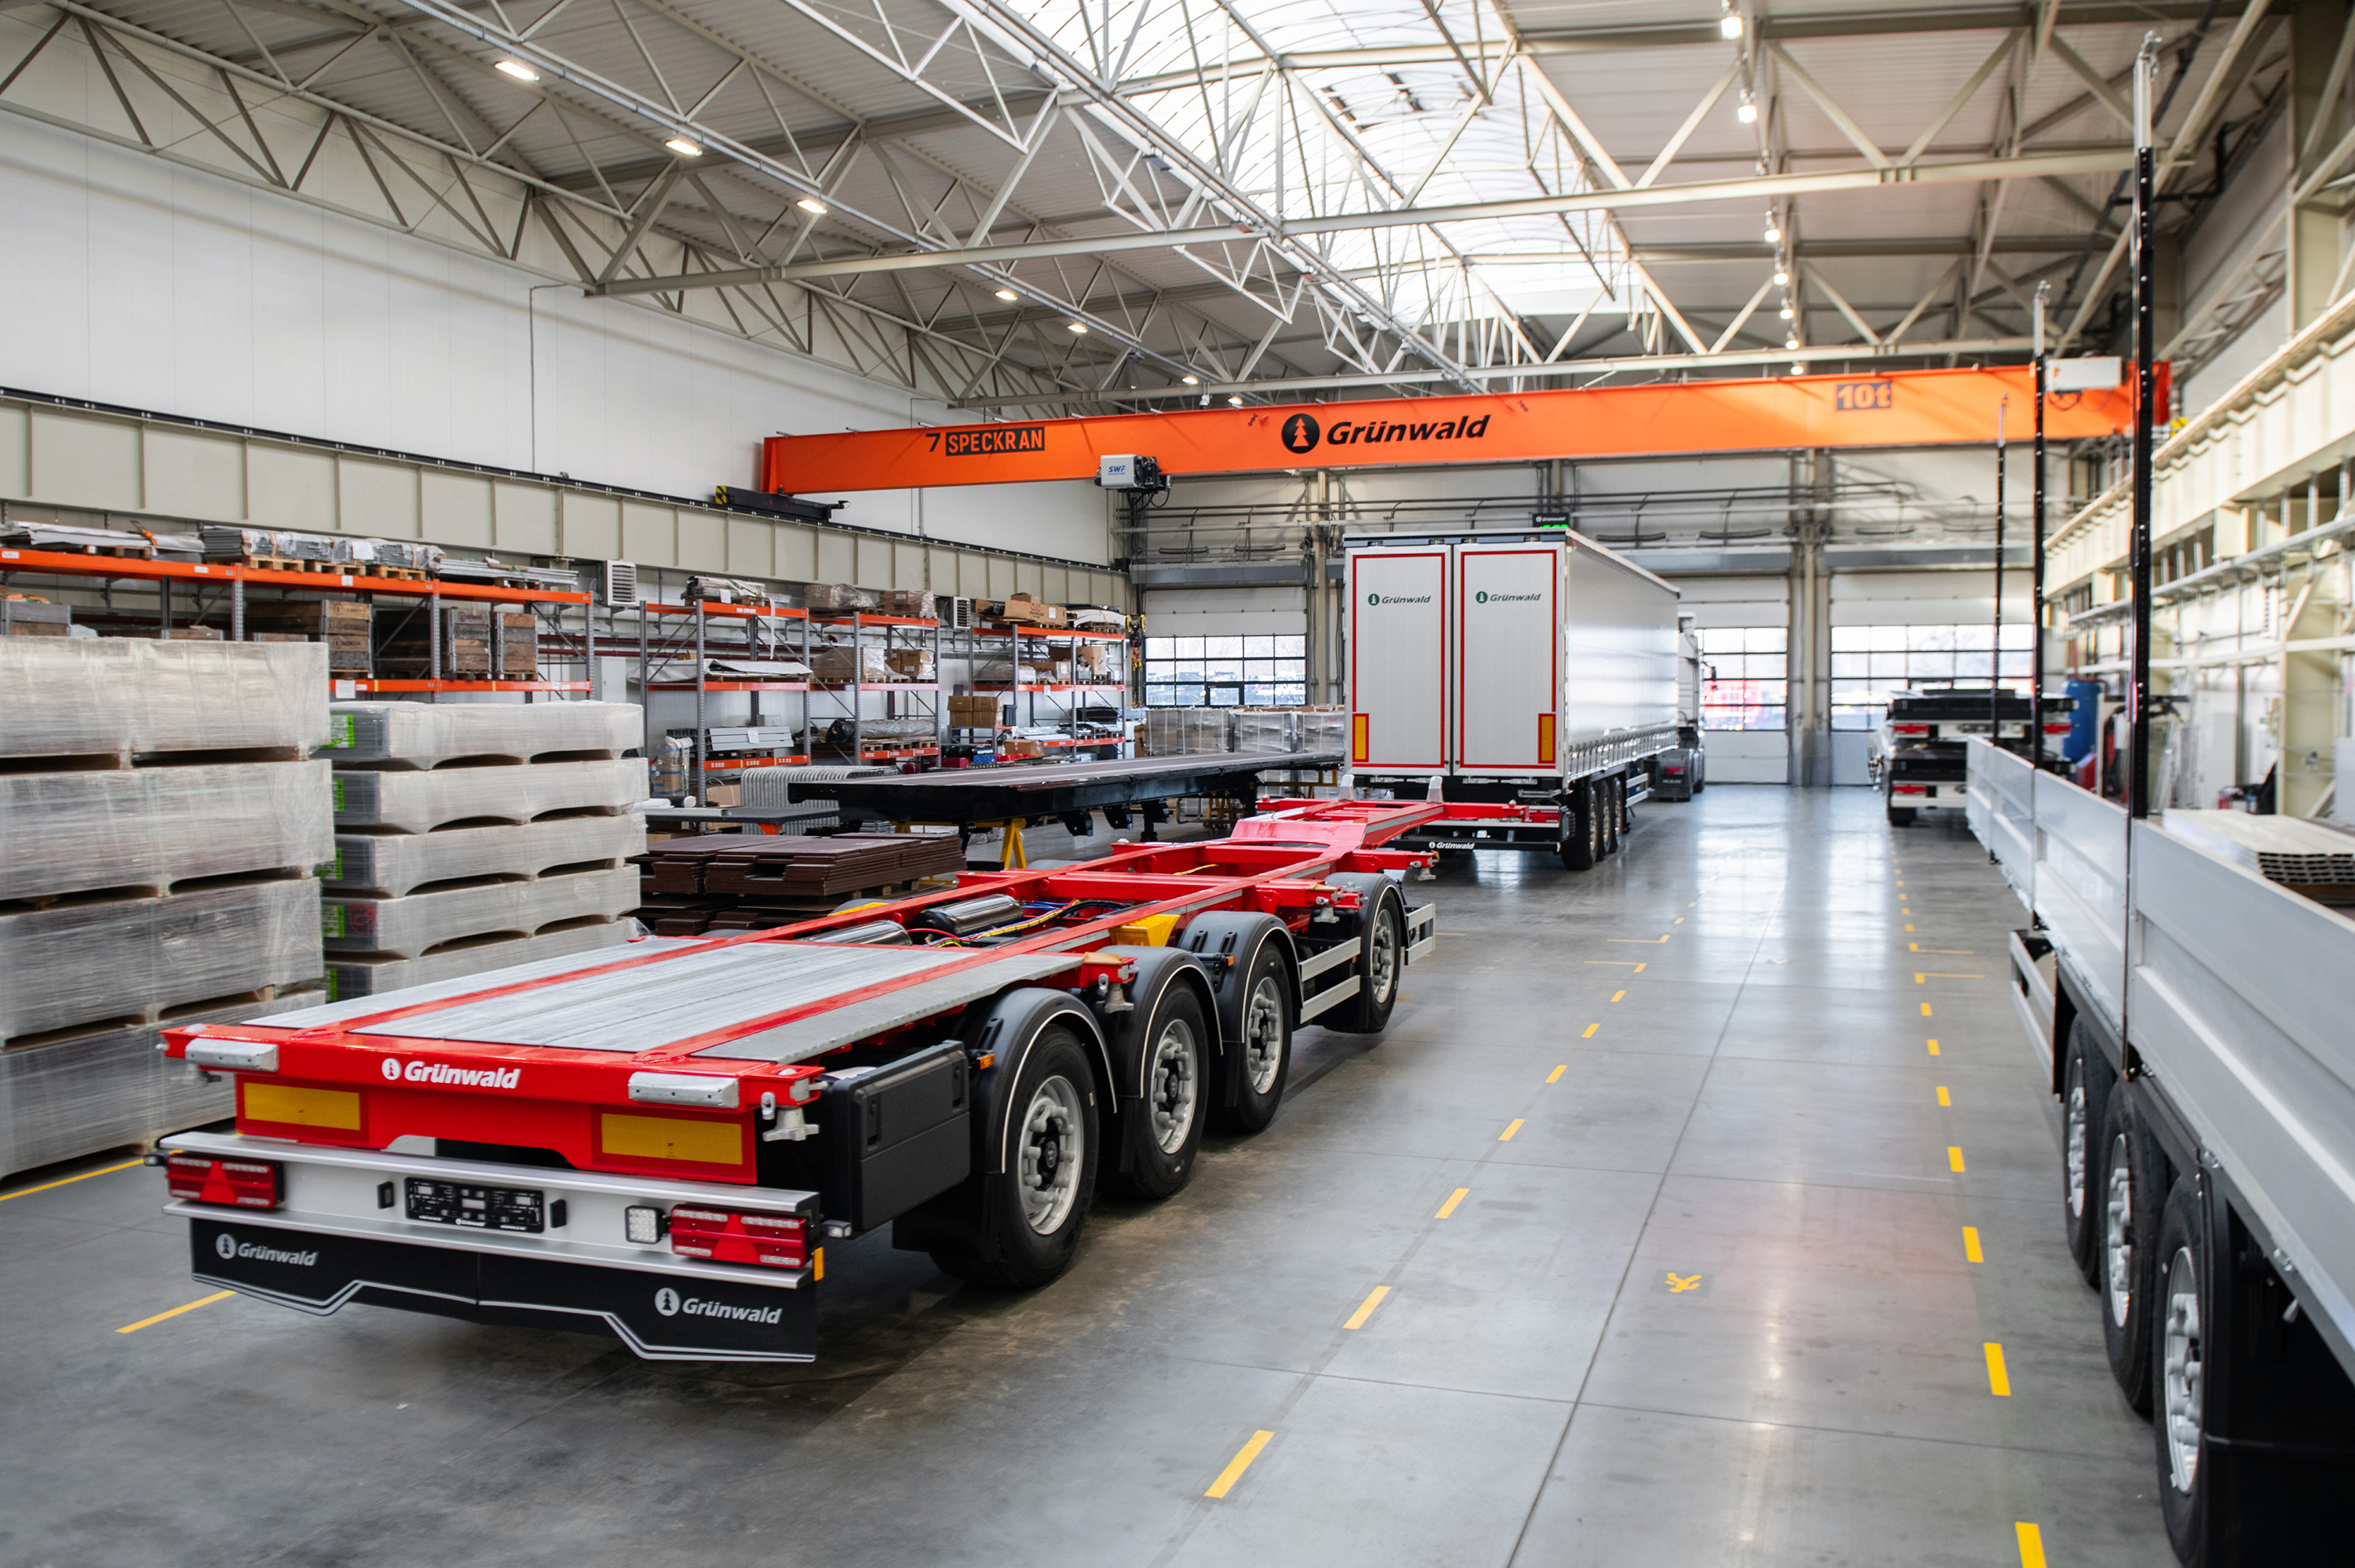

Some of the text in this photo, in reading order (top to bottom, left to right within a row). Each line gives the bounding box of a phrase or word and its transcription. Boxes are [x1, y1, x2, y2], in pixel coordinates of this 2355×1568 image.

[1838, 384, 1891, 409] 10t
[948, 429, 1043, 454] SPECKRAN
[1327, 414, 1491, 445] Grünwald
[1382, 596, 1431, 604] Grünwald
[1490, 593, 1541, 602] Grünwald
[404, 1061, 521, 1088] Grünwald
[237, 1242, 318, 1266] Grünwald
[682, 1297, 783, 1324] Grünwald
